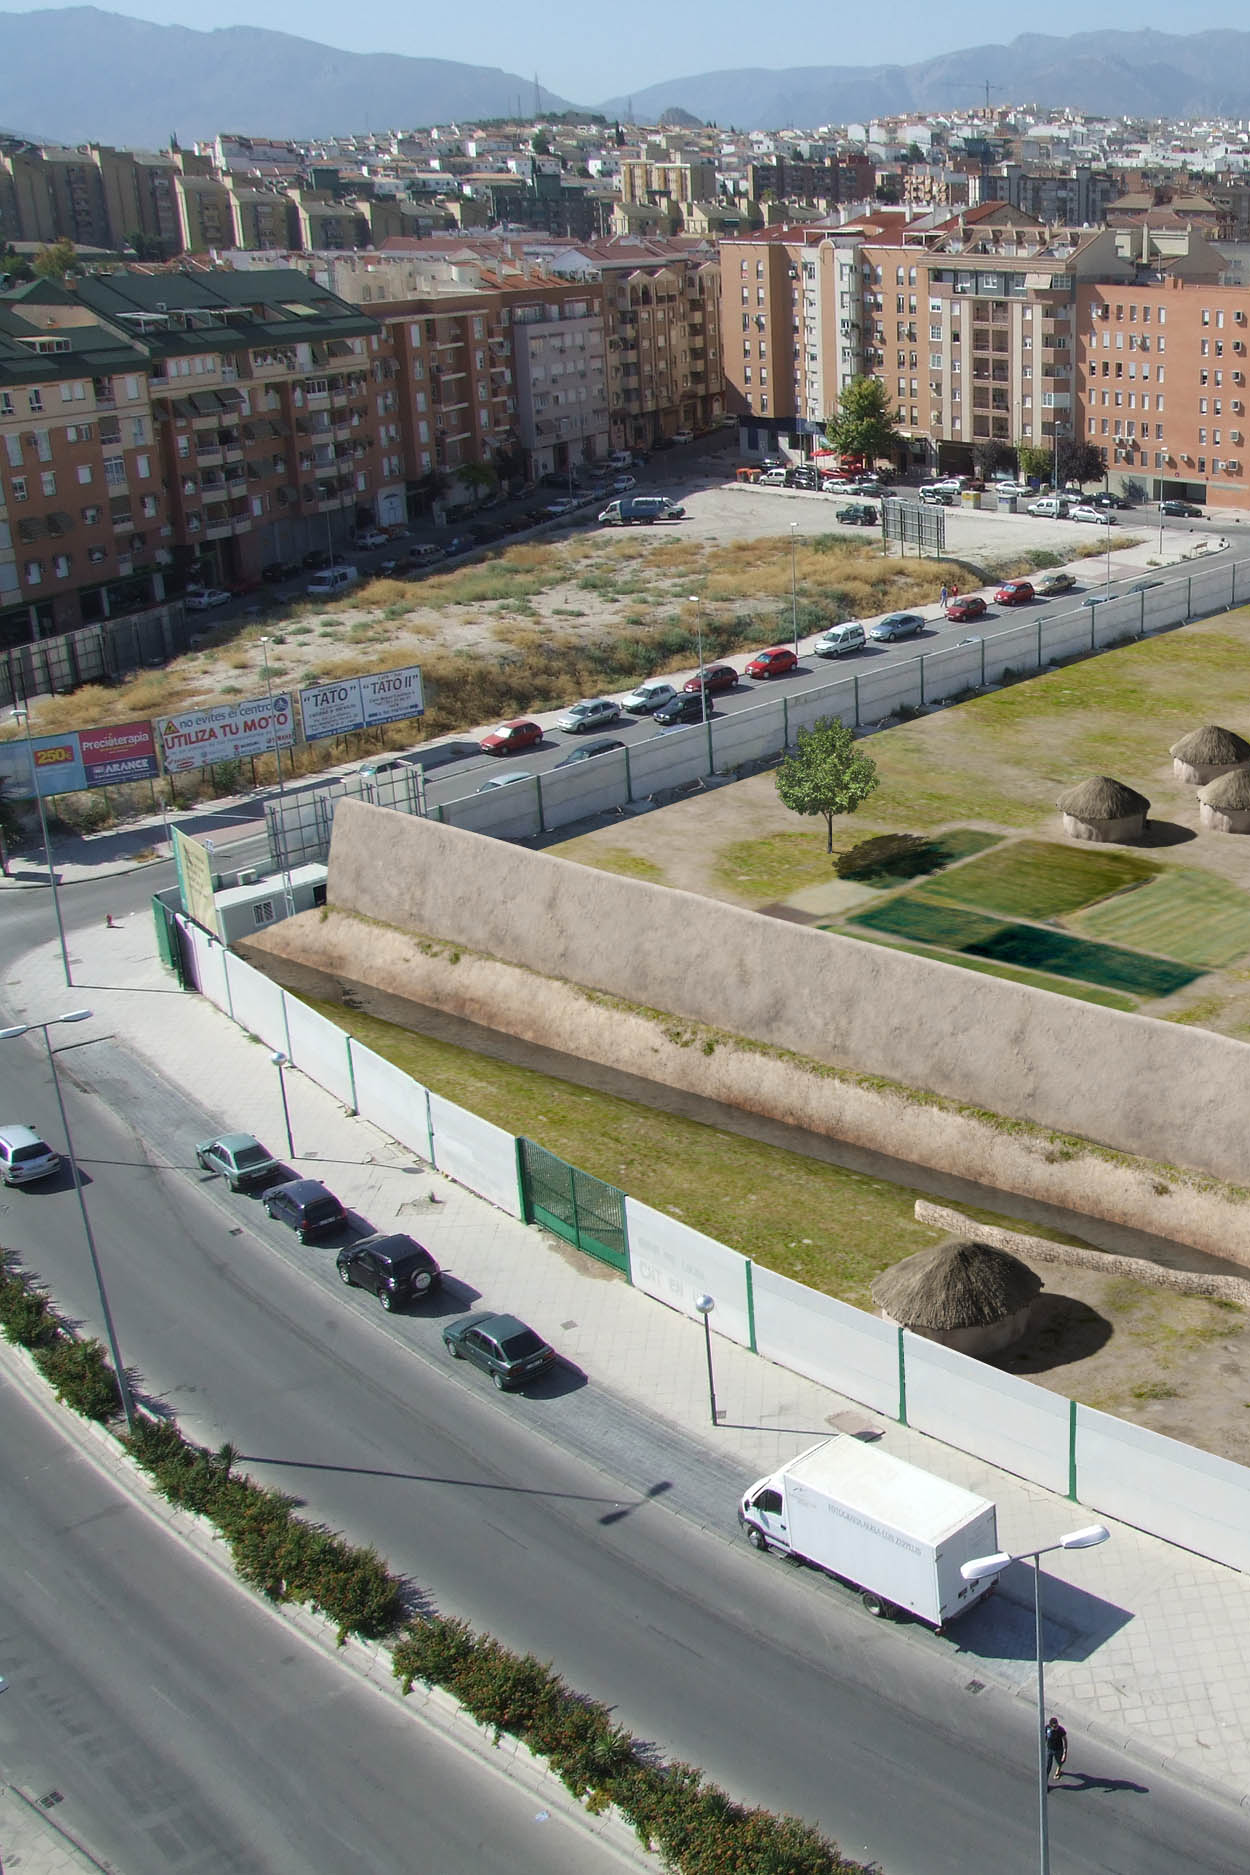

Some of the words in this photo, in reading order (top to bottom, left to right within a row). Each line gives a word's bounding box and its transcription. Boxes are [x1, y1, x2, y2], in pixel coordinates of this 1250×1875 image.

[180, 719, 194, 729] no
[196, 712, 226, 726] evites
[83, 731, 150, 751] Precioterapia
[165, 728, 218, 750] UTILIZA
[219, 723, 240, 737] TU
[105, 758, 149, 773] ARANCE
